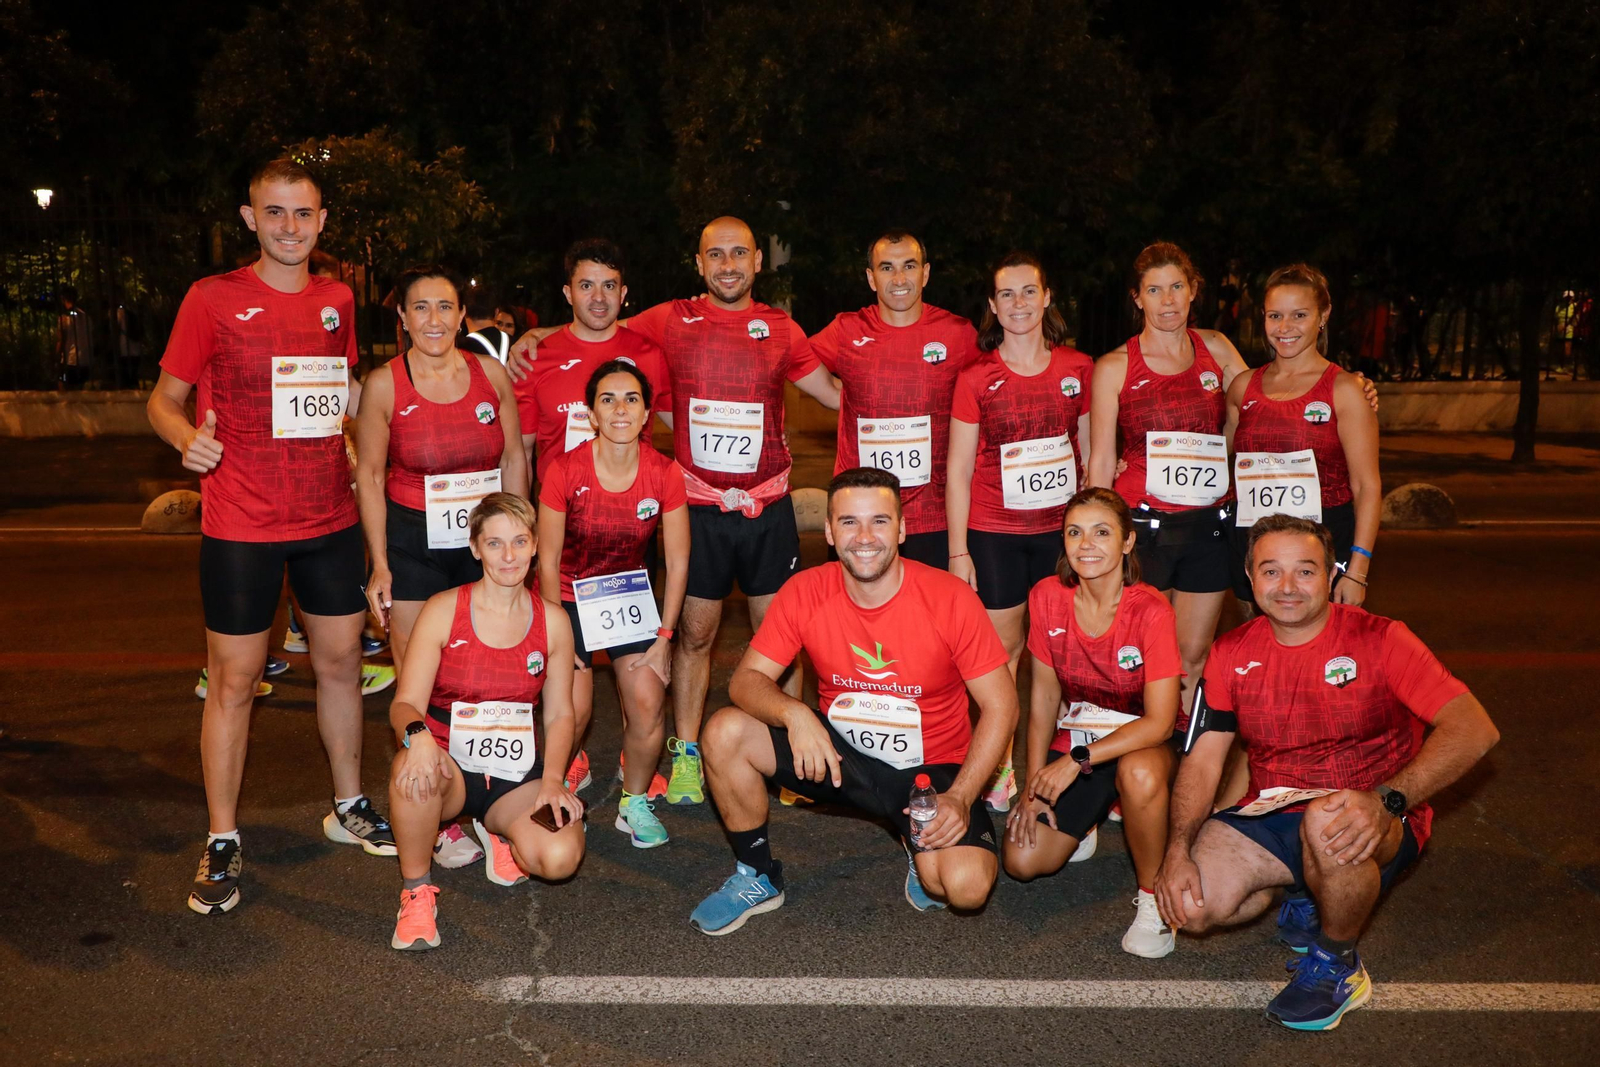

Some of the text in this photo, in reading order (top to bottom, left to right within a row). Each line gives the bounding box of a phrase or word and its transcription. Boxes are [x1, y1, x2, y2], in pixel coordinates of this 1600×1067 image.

[290, 394, 340, 417] 1683
[700, 433, 751, 455] 1772
[870, 450, 921, 469] 1618
[1017, 468, 1068, 493] 1625
[1162, 466, 1216, 487] 1672
[1249, 485, 1306, 507] 1679
[600, 605, 641, 630] 319
[832, 674, 922, 694] Extremadura
[465, 738, 523, 760] 1859
[846, 729, 908, 752] 1675
